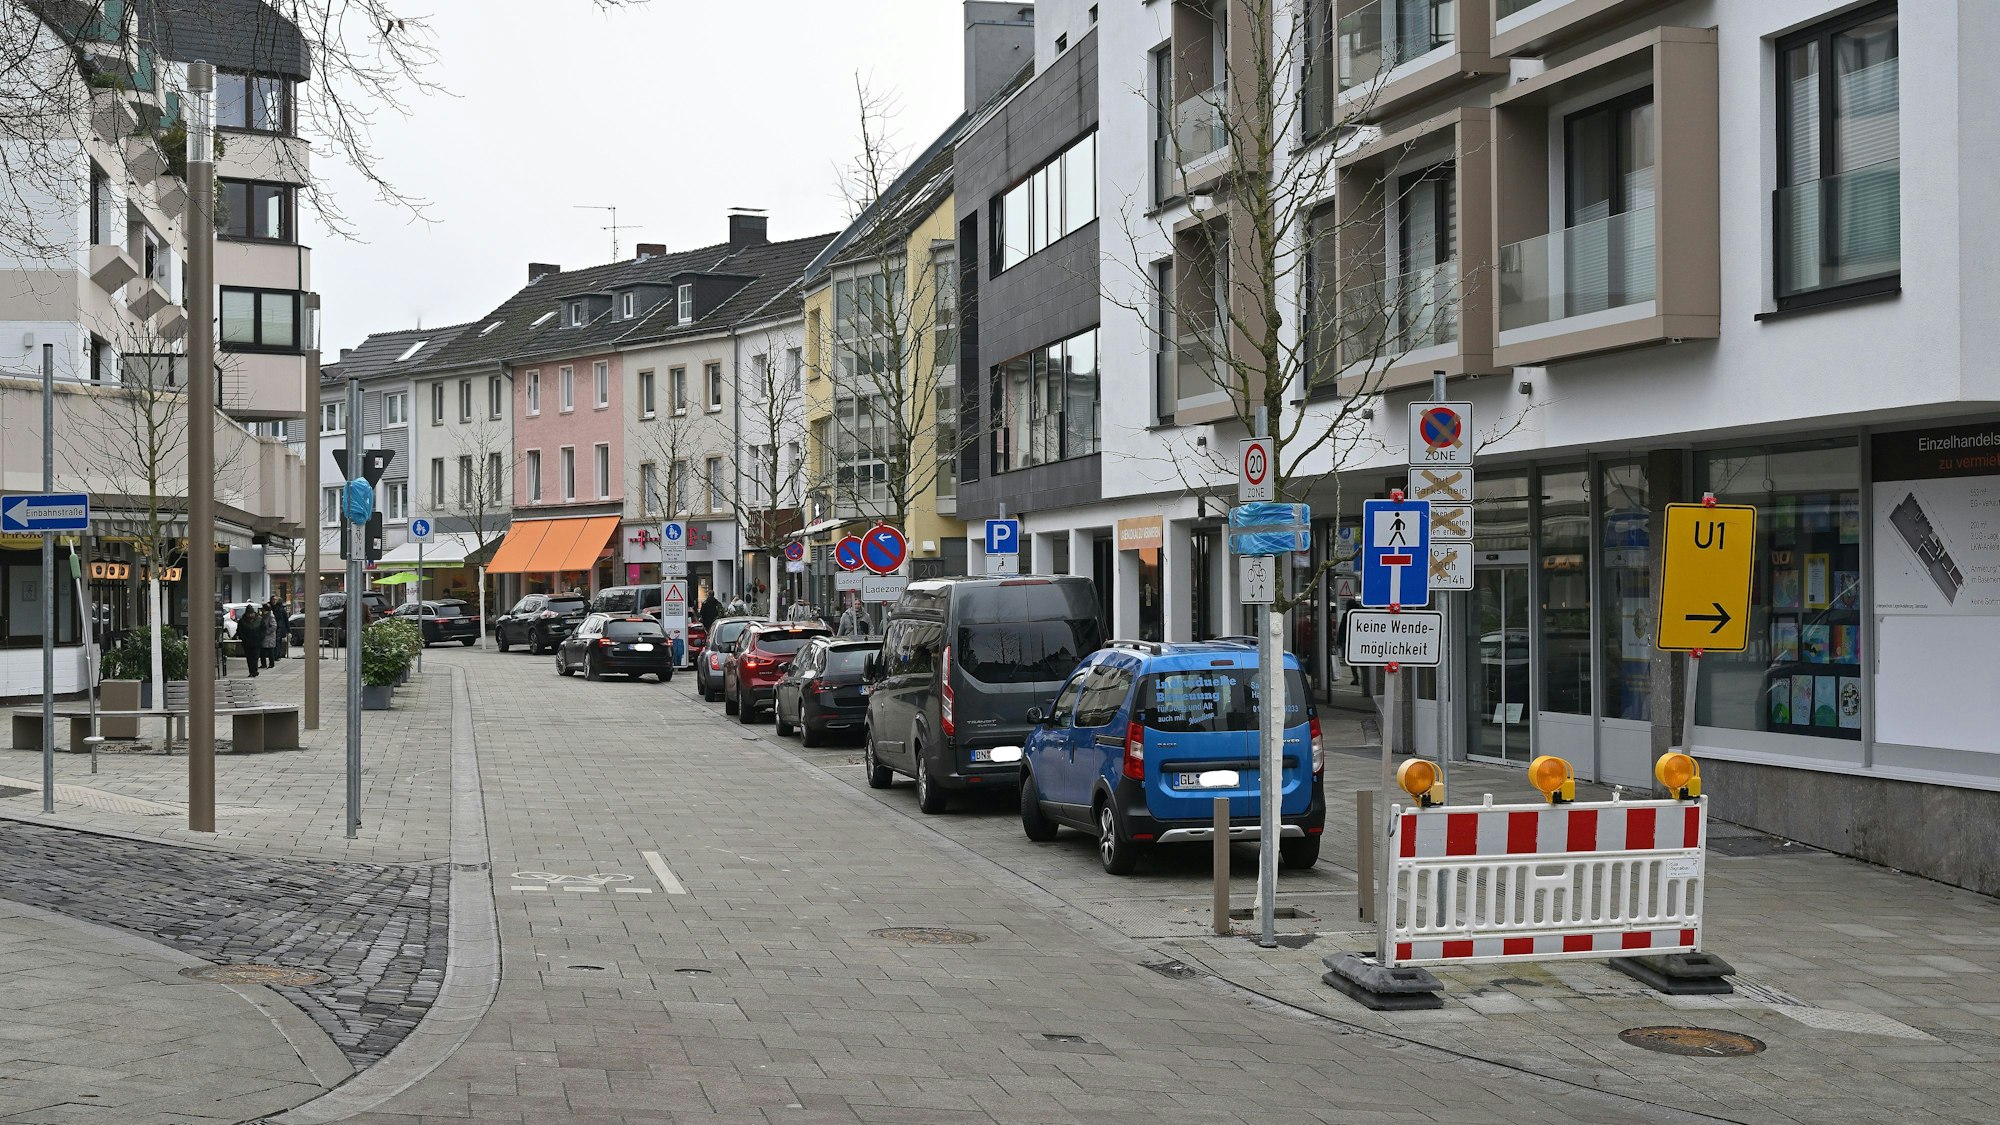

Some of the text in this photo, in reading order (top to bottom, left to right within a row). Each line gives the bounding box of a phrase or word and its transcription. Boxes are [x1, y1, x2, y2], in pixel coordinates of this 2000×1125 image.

[1425, 450, 1456, 461] ZONE
[1249, 455, 1263, 474] 20
[1939, 459, 1953, 470] zu
[1433, 475, 1449, 484] mit
[1247, 487, 1265, 498] ZONE
[1414, 486, 1468, 496] Parkschein
[26, 507, 83, 518] Einbahnstraße
[993, 524, 1011, 550] P
[1694, 521, 1725, 550] U1
[919, 564, 938, 578] 20
[865, 585, 905, 594] Ladezone
[1356, 619, 1434, 634] keine Wende-
[1360, 641, 1428, 658] möglichkeit
[1155, 675, 1237, 690] Individuelle
[1188, 703, 1202, 711] und
[1203, 702, 1213, 710] Alt
[1158, 714, 1173, 723] auch
[1174, 713, 1185, 721] mit
[1180, 774, 1195, 785] GL
